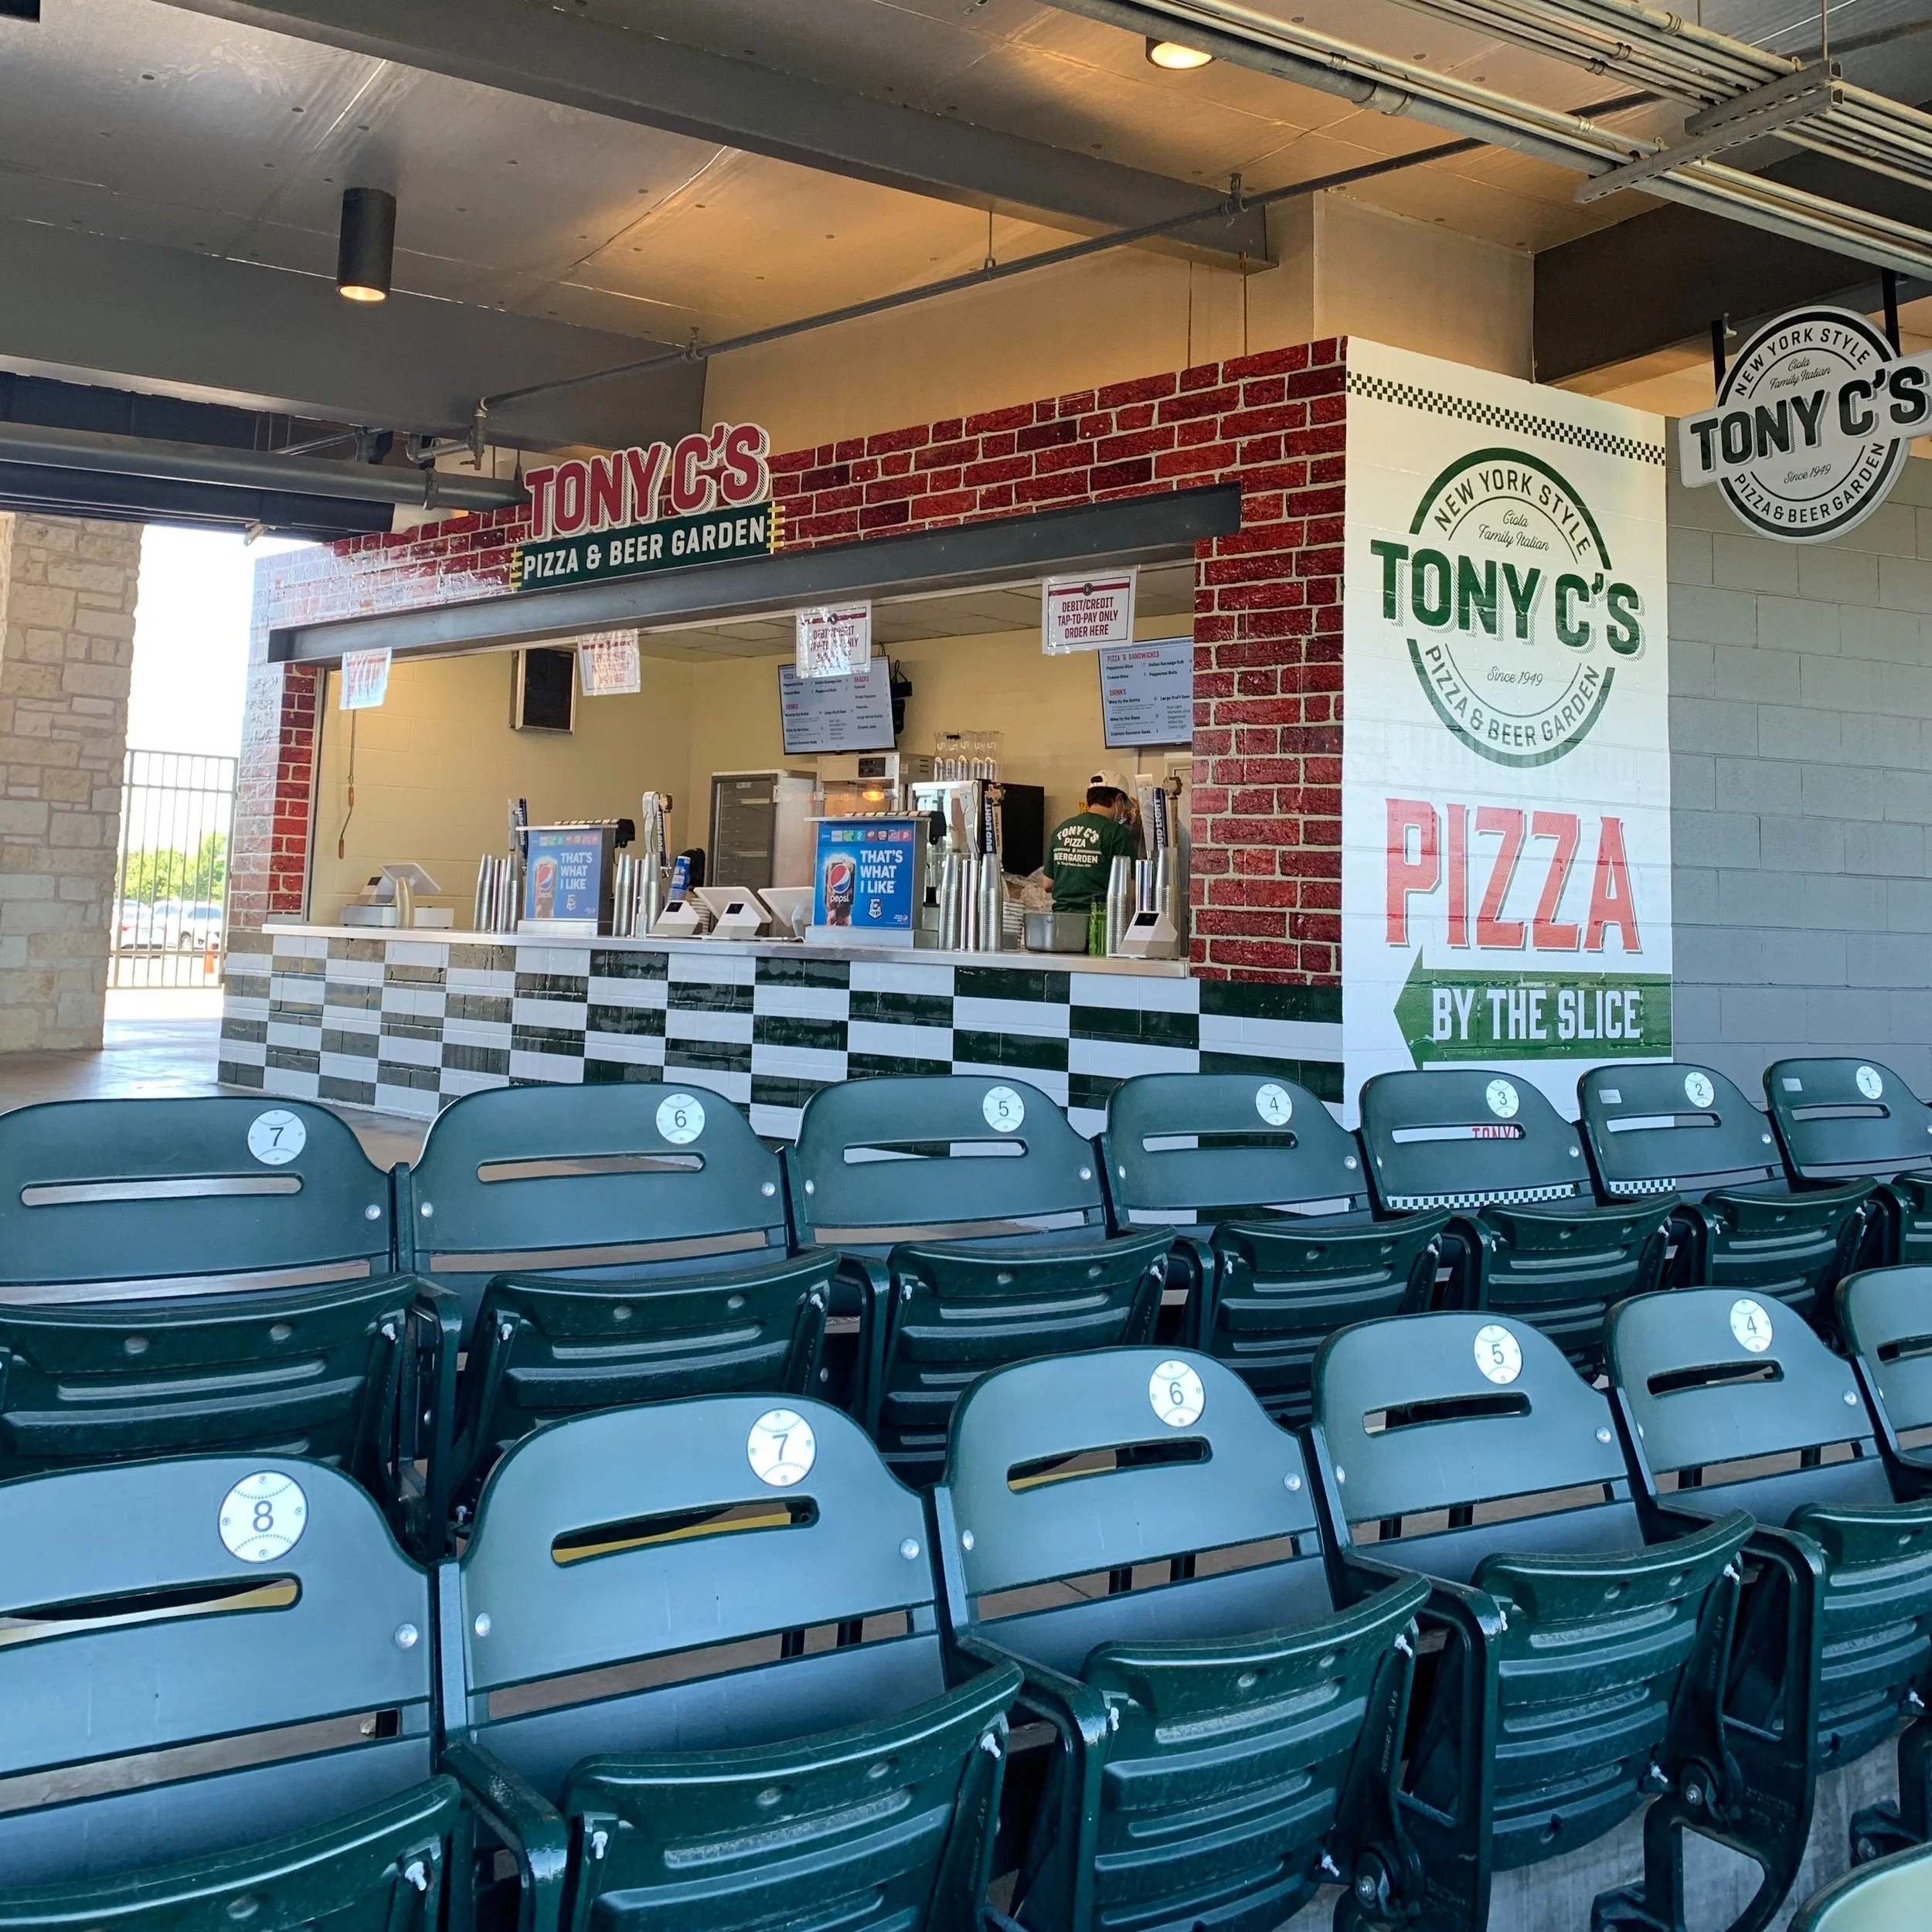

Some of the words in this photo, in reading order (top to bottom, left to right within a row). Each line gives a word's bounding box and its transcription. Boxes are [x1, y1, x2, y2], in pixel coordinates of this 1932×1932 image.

[1735, 354, 1764, 397] NEW
[1767, 328, 1814, 357] YORK
[1820, 328, 1871, 366] STYLE
[1787, 358, 1811, 372] Ciola
[1770, 372, 1801, 390] Family
[1801, 366, 1832, 383] Italian
[1690, 389, 1831, 473] TONY
[1838, 366, 1930, 438] C'S
[525, 442, 671, 540] TONY
[672, 423, 770, 513] C'S
[1734, 473, 1770, 516] PIZZA
[1773, 505, 1784, 520] &
[1788, 503, 1831, 523] BEER
[1832, 442, 1885, 512] GARDEN
[1784, 469, 1808, 484] Since
[1809, 464, 1832, 480] 1949
[1434, 478, 1475, 532] NEW
[1478, 468, 1533, 495] YORK
[1539, 485, 1591, 556] STYLE
[1502, 510, 1529, 527] Ciola
[1478, 525, 1515, 548] Family
[1515, 532, 1549, 551] Italian
[524, 549, 578, 580] PIZZA
[587, 544, 601, 570] &
[610, 533, 662, 565] BEER
[672, 516, 765, 556] GARDEN
[1062, 597, 1114, 613] DEBIT/CREDIT
[1371, 539, 1546, 645] TONY
[1555, 573, 1646, 661] C'S
[1057, 612, 1097, 626] TAP-TO-PAY
[1099, 610, 1118, 622] ONLY
[1065, 626, 1088, 638] ORDER
[1090, 624, 1109, 636] HERE
[1129, 651, 1159, 660] SANDWICHES
[1487, 665, 1516, 684] Since
[1518, 671, 1543, 686] 1949
[1425, 645, 1468, 719] PIZZA
[1470, 707, 1484, 730] &
[1488, 717, 1537, 748] BEER
[1541, 665, 1600, 743] GARDEN
[1155, 799, 1163, 828] LIGHT
[1056, 825, 1084, 840] TONY
[1083, 828, 1100, 844] C'S
[1064, 837, 1086, 848] PIZZA
[560, 852, 593, 864] THAT'S
[860, 850, 903, 863] THAT'S
[560, 866, 587, 877] WHAT
[860, 866, 896, 878] WHAT
[1386, 798, 1643, 954] PIZZA
[560, 879, 563, 889] I
[566, 879, 587, 889] LIKE
[860, 881, 864, 893] I
[868, 880, 895, 894] LIKE
[830, 893, 849, 904] pepsi
[1432, 988, 1475, 1040] BY
[1486, 988, 1546, 1039] THE
[1558, 990, 1641, 1039] SLICE
[1695, 1083, 1704, 1096] 2
[1865, 1077, 1872, 1089] 1
[1270, 1097, 1279, 1111] 4
[1498, 1091, 1508, 1105] 3
[998, 1100, 1009, 1117] 5
[674, 1109, 687, 1128] 6
[270, 1127, 284, 1146] 7
[1747, 1315, 1757, 1335] 4
[1492, 1343, 1505, 1365] 5
[1169, 1382, 1184, 1406] 6
[773, 1434, 788, 1461] 7
[252, 1500, 274, 1533] 8
